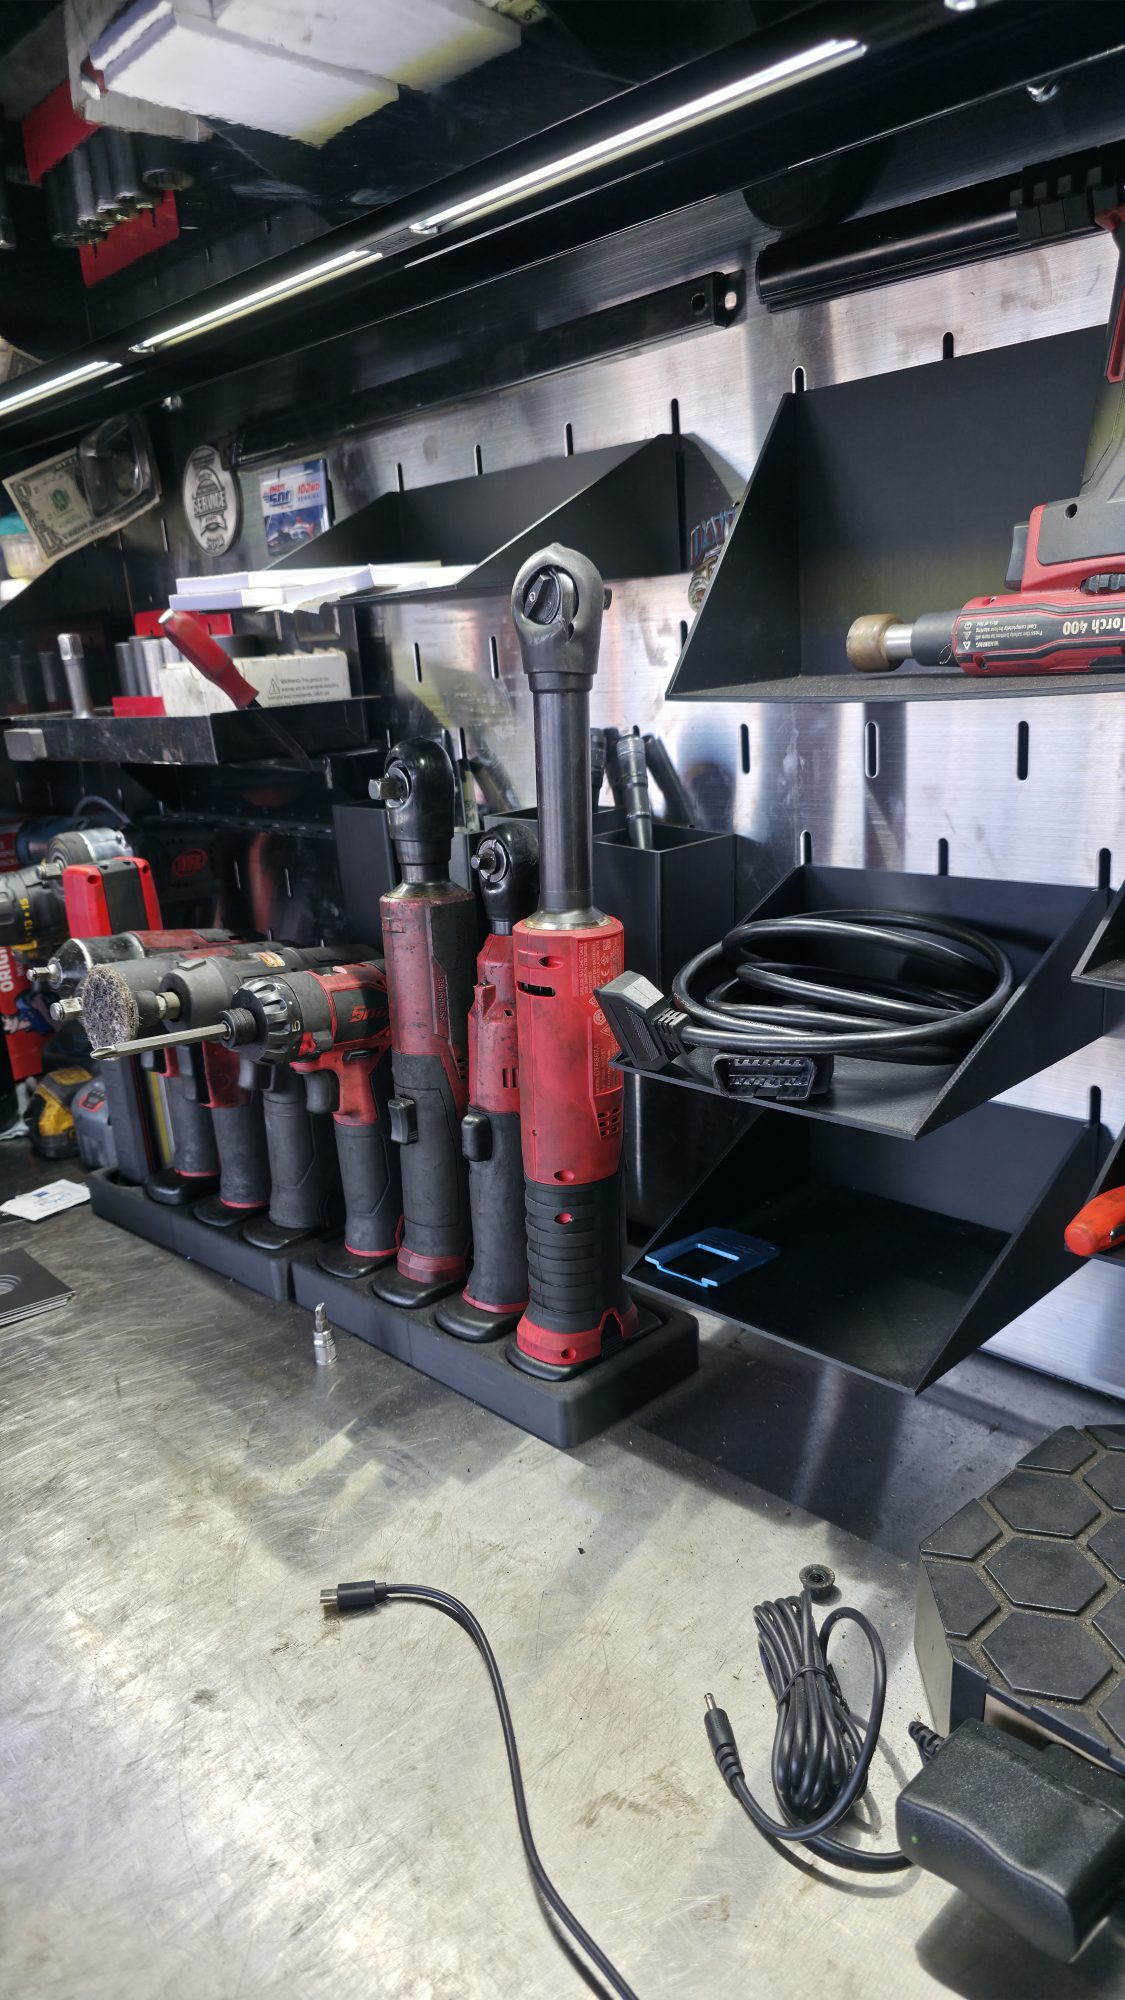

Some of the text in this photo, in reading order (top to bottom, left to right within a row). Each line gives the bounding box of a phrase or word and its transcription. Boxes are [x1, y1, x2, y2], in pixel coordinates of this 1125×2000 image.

[193, 491, 226, 515] SERVICE
[1062, 621, 1088, 635] 400
[0, 944, 14, 992] ORIGI
[291, 1020, 301, 1033] 5
